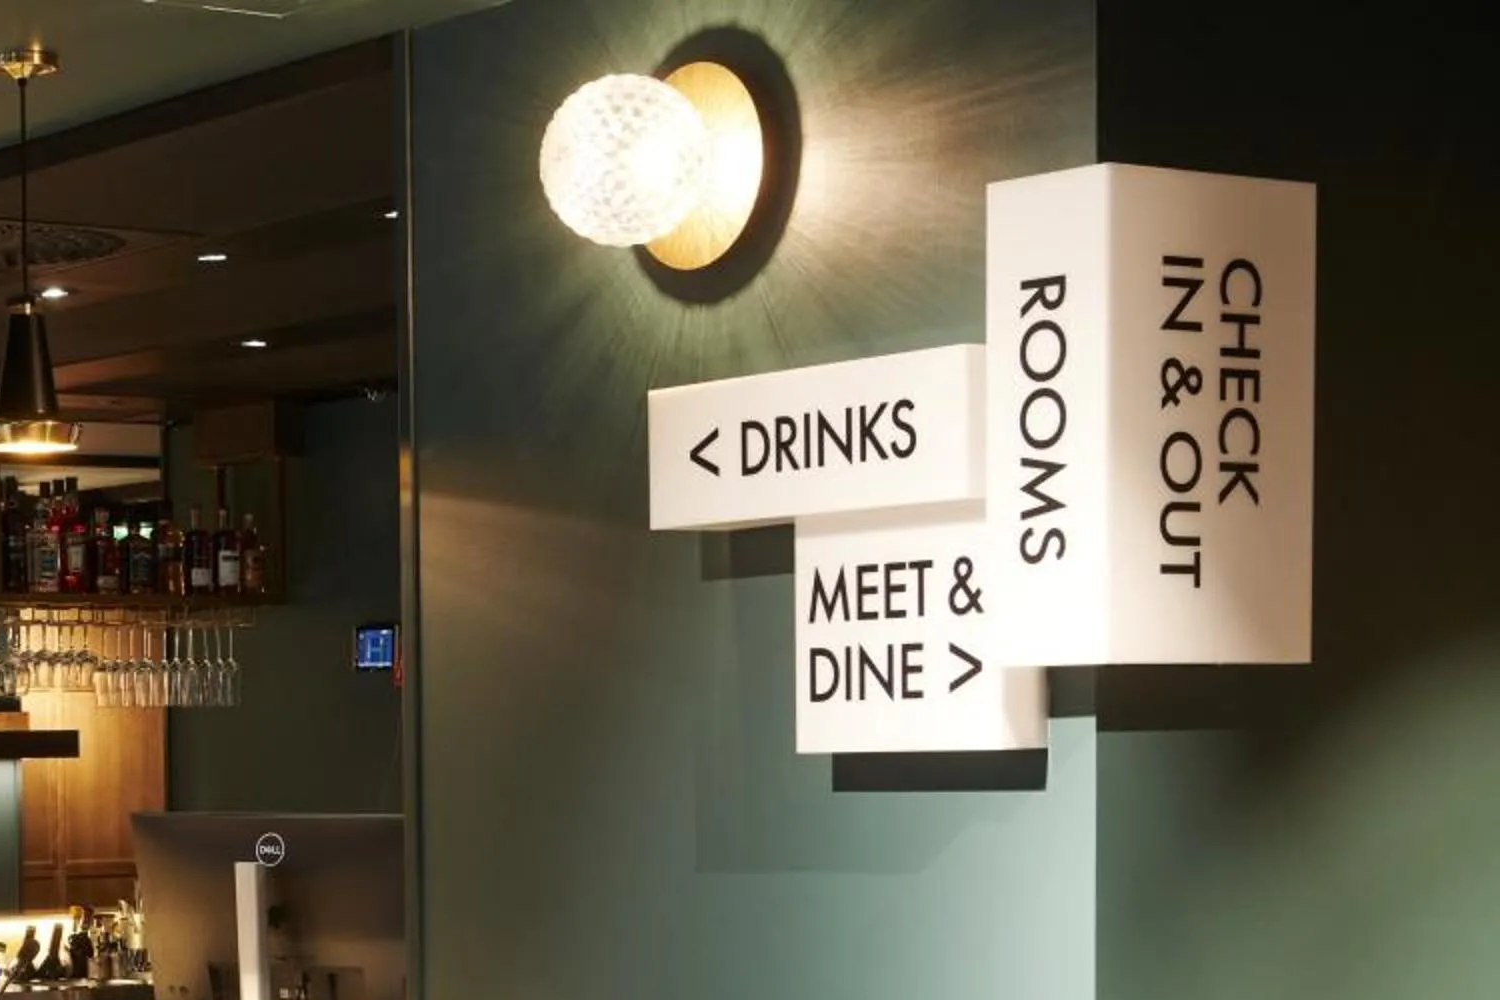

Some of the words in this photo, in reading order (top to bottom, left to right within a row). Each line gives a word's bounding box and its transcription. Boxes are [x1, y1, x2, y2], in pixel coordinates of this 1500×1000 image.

[1160, 255, 1205, 332] IN
[1019, 274, 1067, 565] ROOMS
[1160, 356, 1204, 409] &
[1217, 257, 1263, 507] CHECK
[740, 398, 917, 477] DRINKS
[1159, 431, 1203, 589] OUT
[808, 559, 934, 624] MEET
[948, 555, 984, 616] &
[809, 642, 924, 703] DINE
